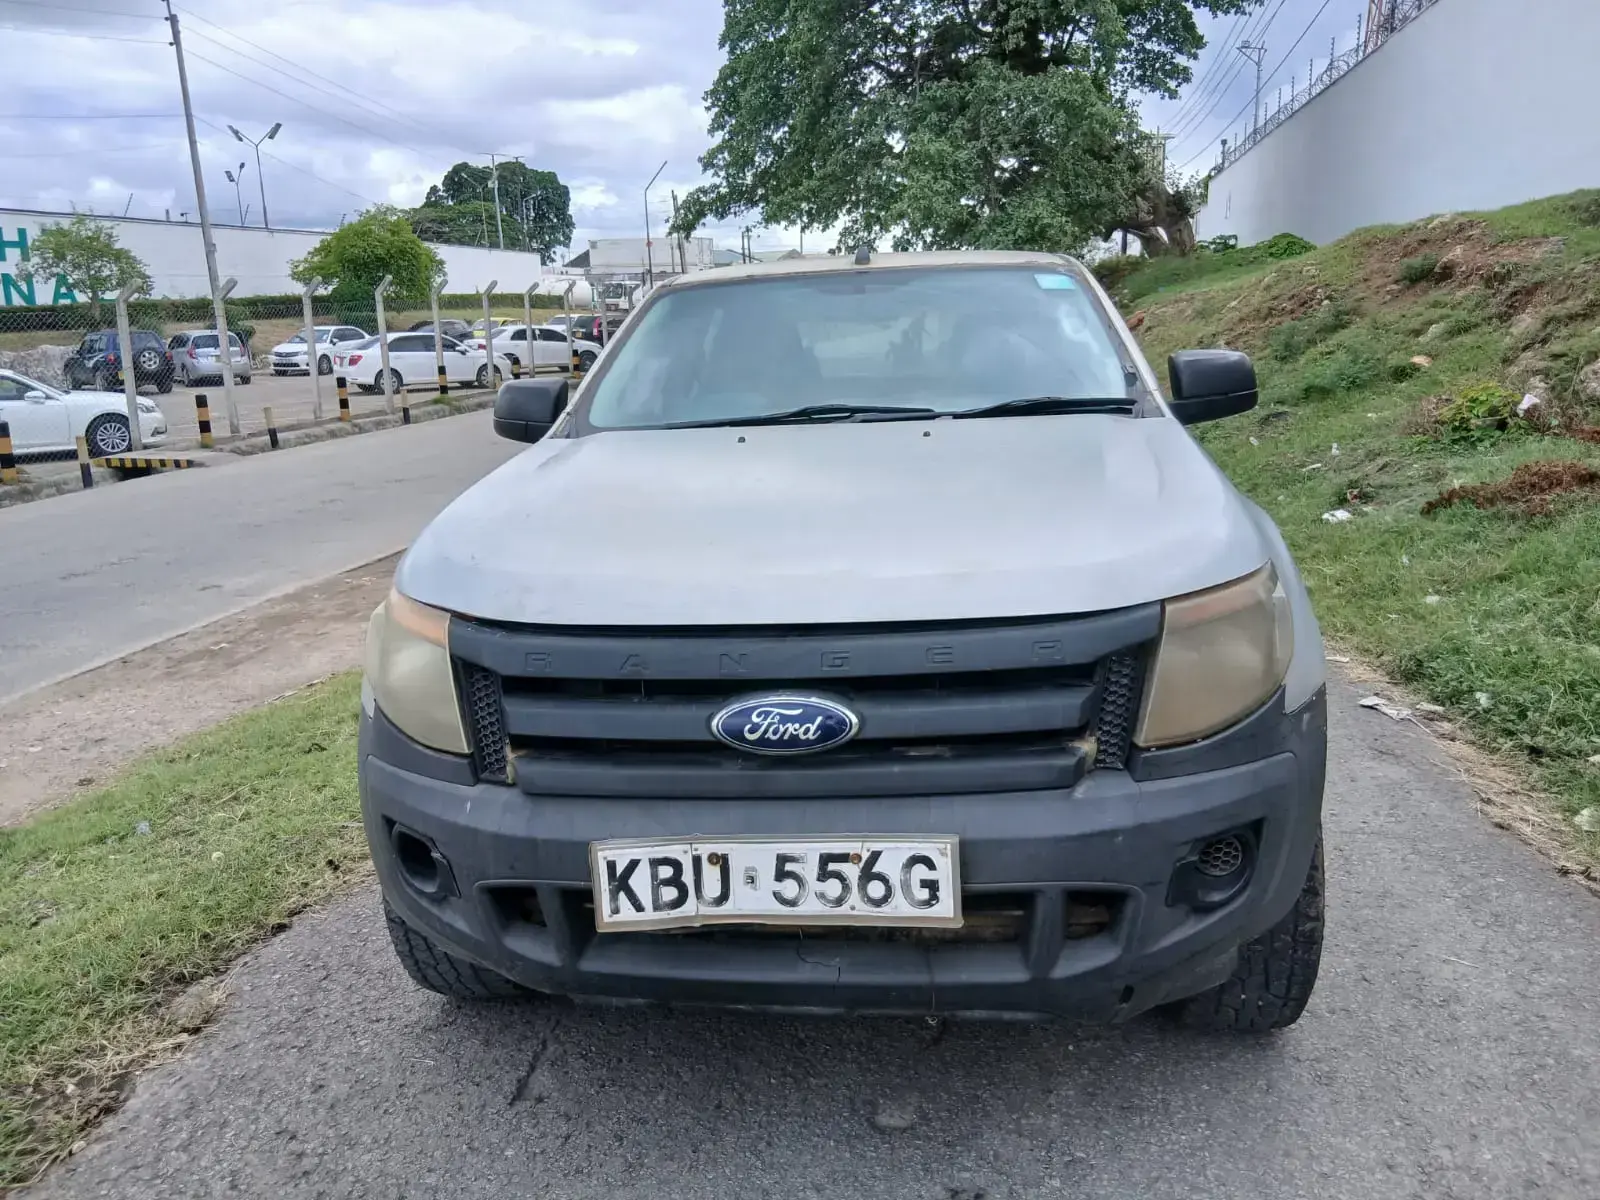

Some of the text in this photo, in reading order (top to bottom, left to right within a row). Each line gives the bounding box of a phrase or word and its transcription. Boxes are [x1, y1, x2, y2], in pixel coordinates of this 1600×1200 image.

[524, 639, 1064, 673] RANGER
[743, 707, 823, 741] Ford
[606, 850, 940, 915] KBU 556G
